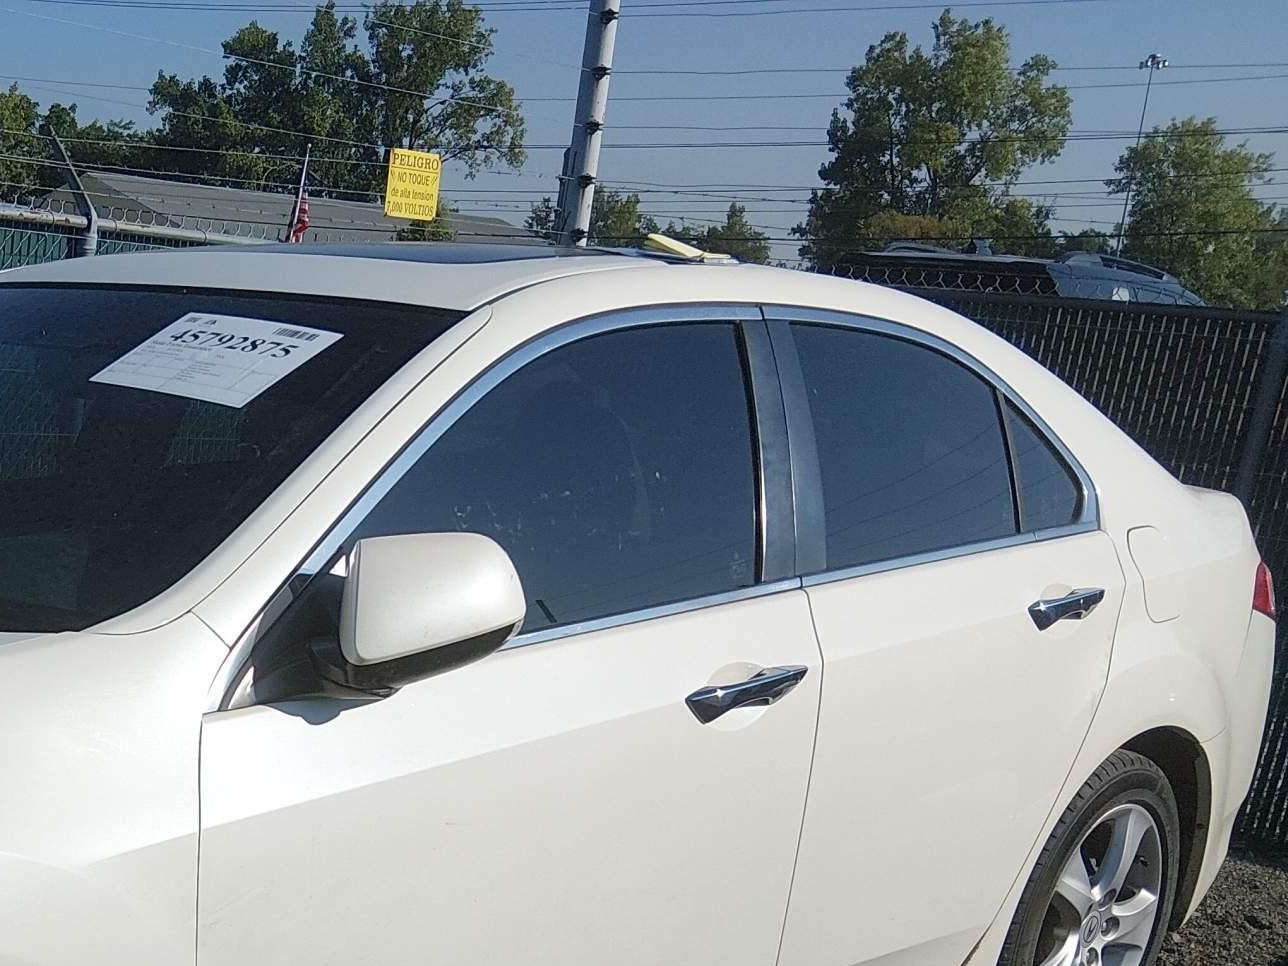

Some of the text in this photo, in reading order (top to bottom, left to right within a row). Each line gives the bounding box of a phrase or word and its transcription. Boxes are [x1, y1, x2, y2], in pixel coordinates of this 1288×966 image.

[392, 153, 439, 171] PELIGRO
[398, 172, 407, 183] NO
[409, 173, 430, 186] TOQUE
[391, 187, 399, 197] de
[404, 202, 433, 217] VOLTIOS
[166, 328, 300, 358] 45792875
